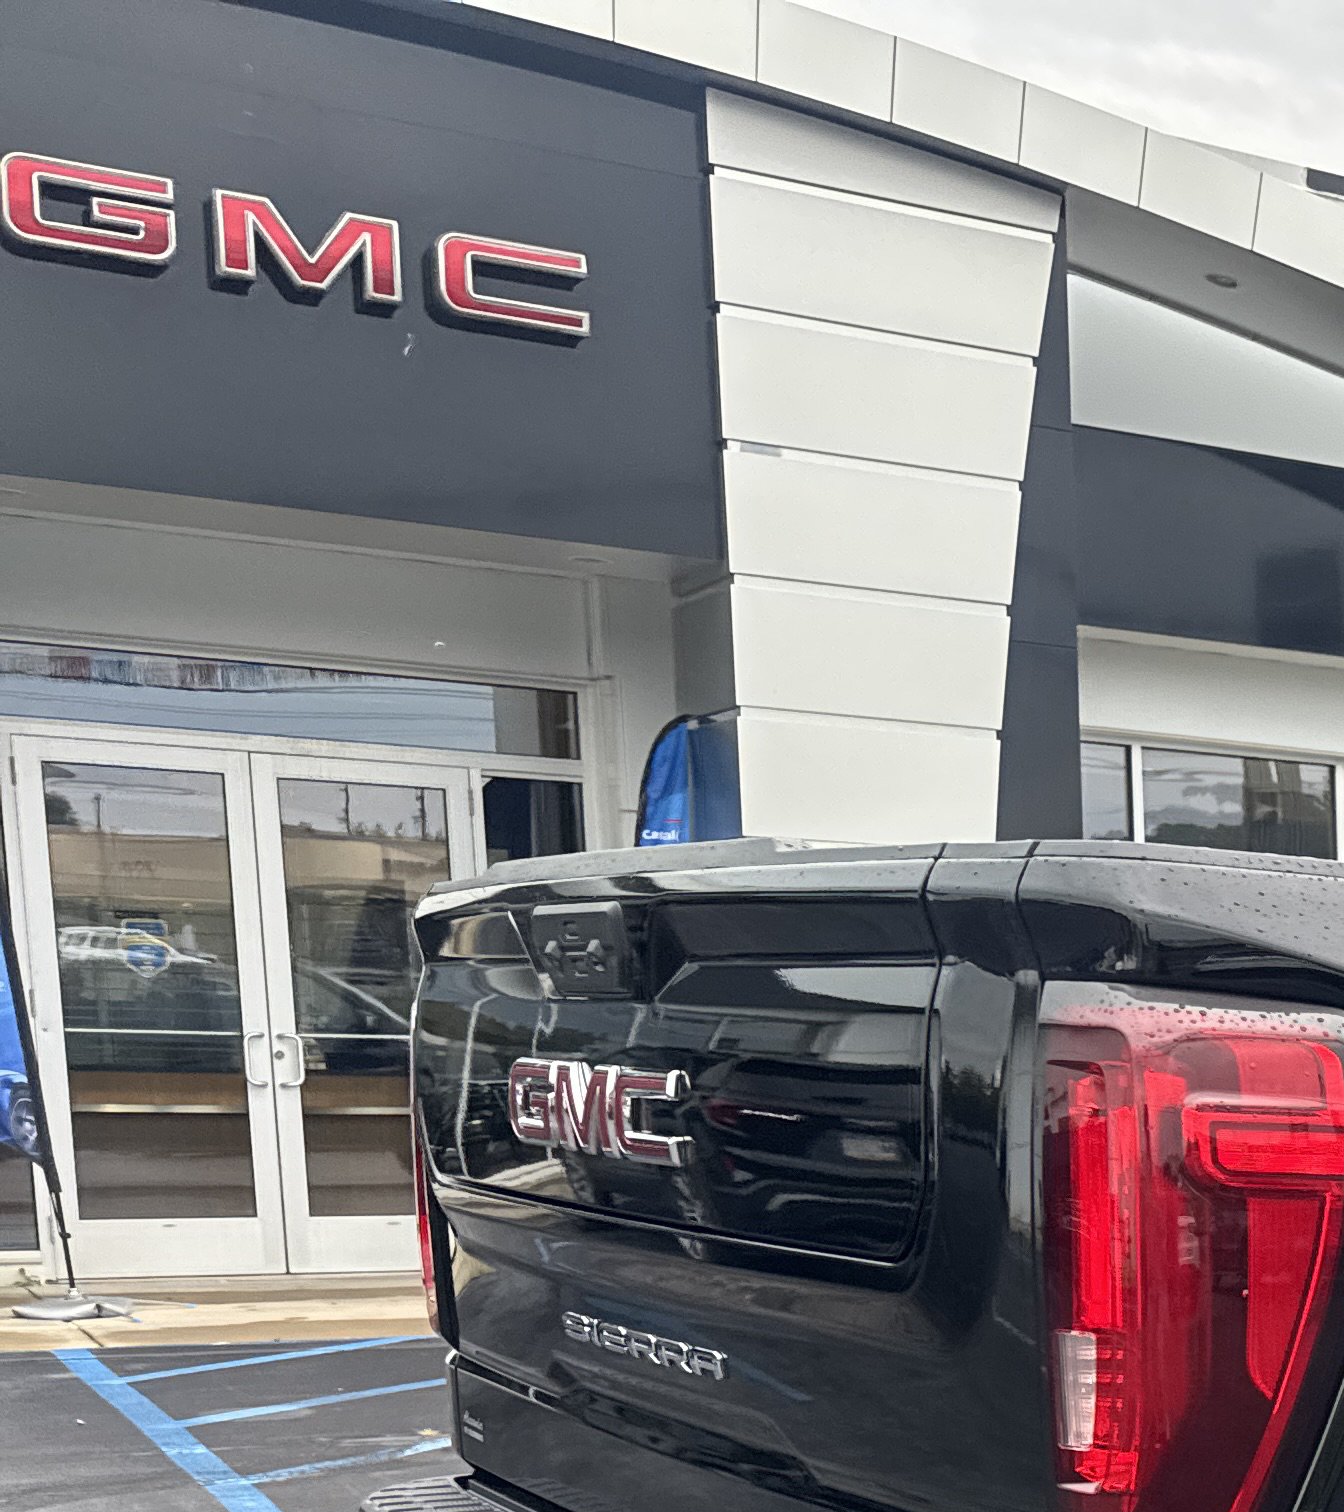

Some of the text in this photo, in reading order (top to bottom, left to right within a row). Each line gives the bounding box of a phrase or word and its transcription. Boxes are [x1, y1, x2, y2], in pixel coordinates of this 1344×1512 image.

[0, 151, 592, 337] GMC
[509, 1057, 692, 1168] GMC
[562, 1311, 728, 1380] SIERRA
